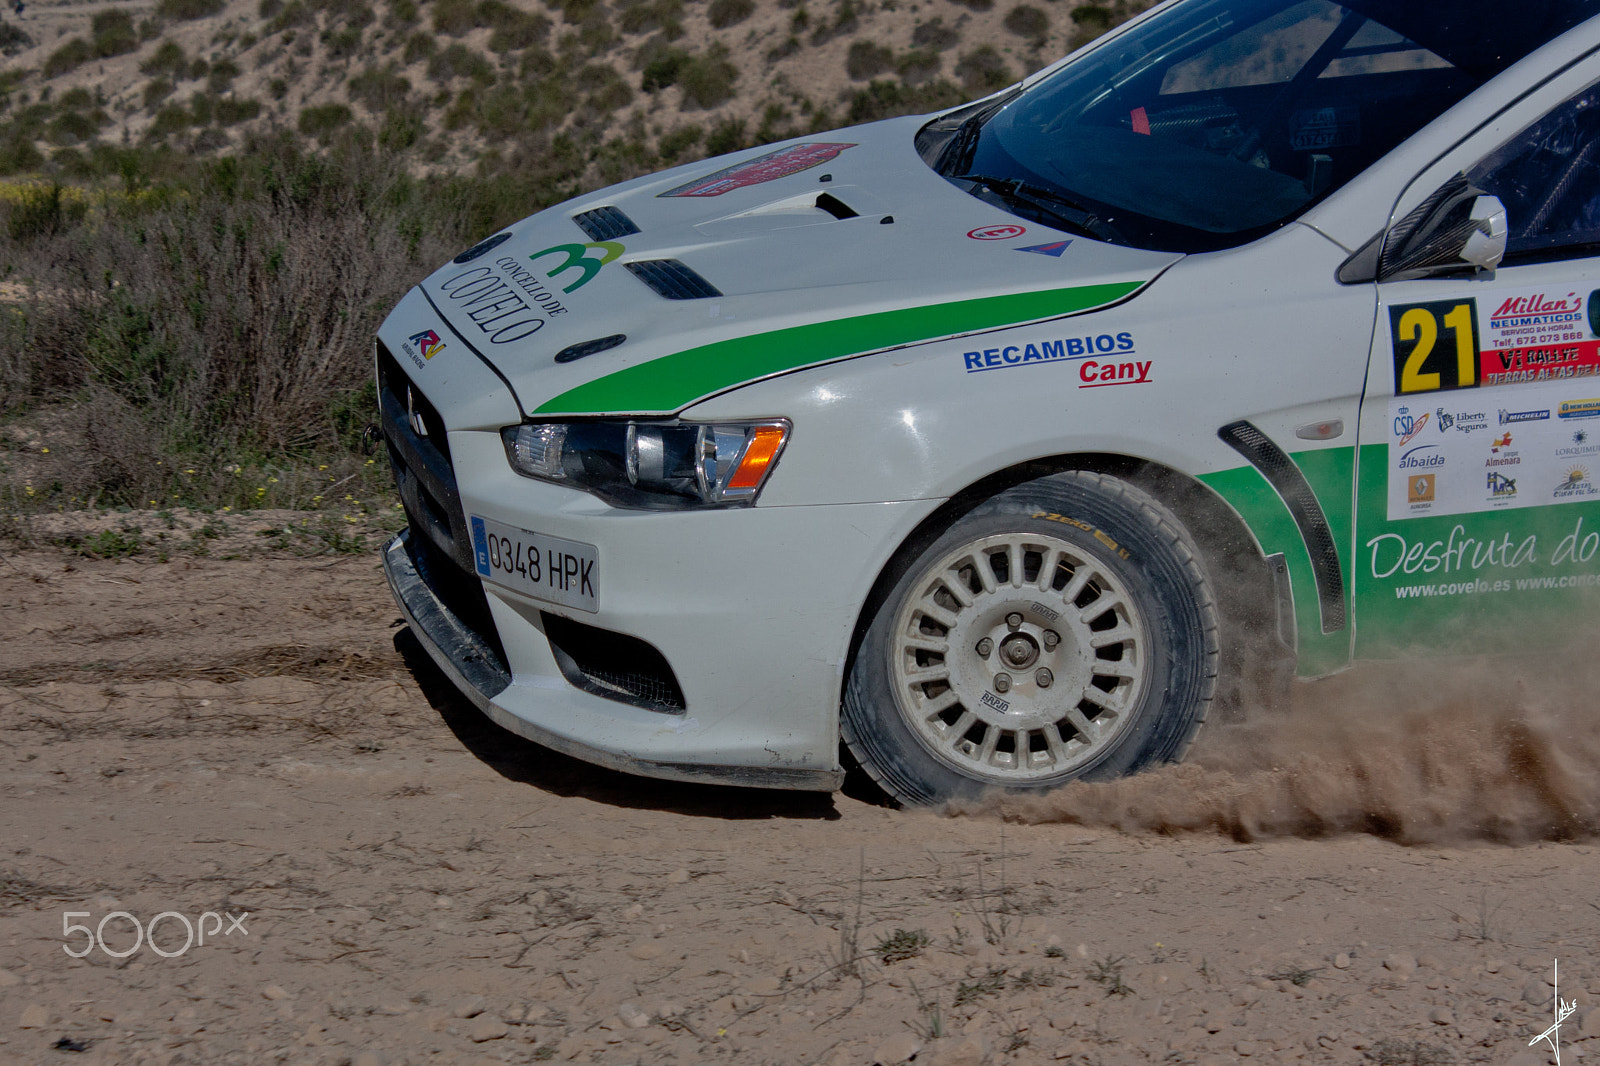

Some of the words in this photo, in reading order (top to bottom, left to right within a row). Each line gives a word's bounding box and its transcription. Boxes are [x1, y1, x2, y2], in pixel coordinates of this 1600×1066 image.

[495, 256, 552, 302] CONCELLO
[541, 299, 568, 318] DE
[441, 267, 545, 344] COVELO
[1491, 313, 1582, 329] NEUMATICOS
[1501, 327, 1535, 336] SERVICIO
[1536, 326, 1547, 334] 24
[1548, 323, 1574, 332] HORAS
[1399, 304, 1474, 392] 21
[1516, 336, 1537, 346] 672
[1540, 334, 1560, 343] 073
[1563, 331, 1583, 341] 868
[963, 332, 1136, 370] RECAMBIOS
[1527, 347, 1579, 366] RALLYE
[1079, 360, 1152, 384] Cany
[1487, 368, 1535, 385] TIERRAS
[1538, 365, 1574, 382] ALTAS
[1576, 363, 1592, 377] DE
[1394, 415, 1414, 437] CSD
[1456, 412, 1487, 423] Liberty
[1509, 411, 1548, 421] MICHELIN
[1456, 423, 1488, 434] Seguros
[1399, 455, 1445, 469] albaida
[1485, 457, 1521, 468] Almenara
[1046, 512, 1092, 532] ZERO
[1366, 524, 1536, 578] Desfruta
[1551, 516, 1600, 566] do
[479, 551, 486, 565] E
[488, 533, 541, 582] 0348
[549, 550, 594, 598] HPK
[1395, 578, 1511, 599] www.covelo.es
